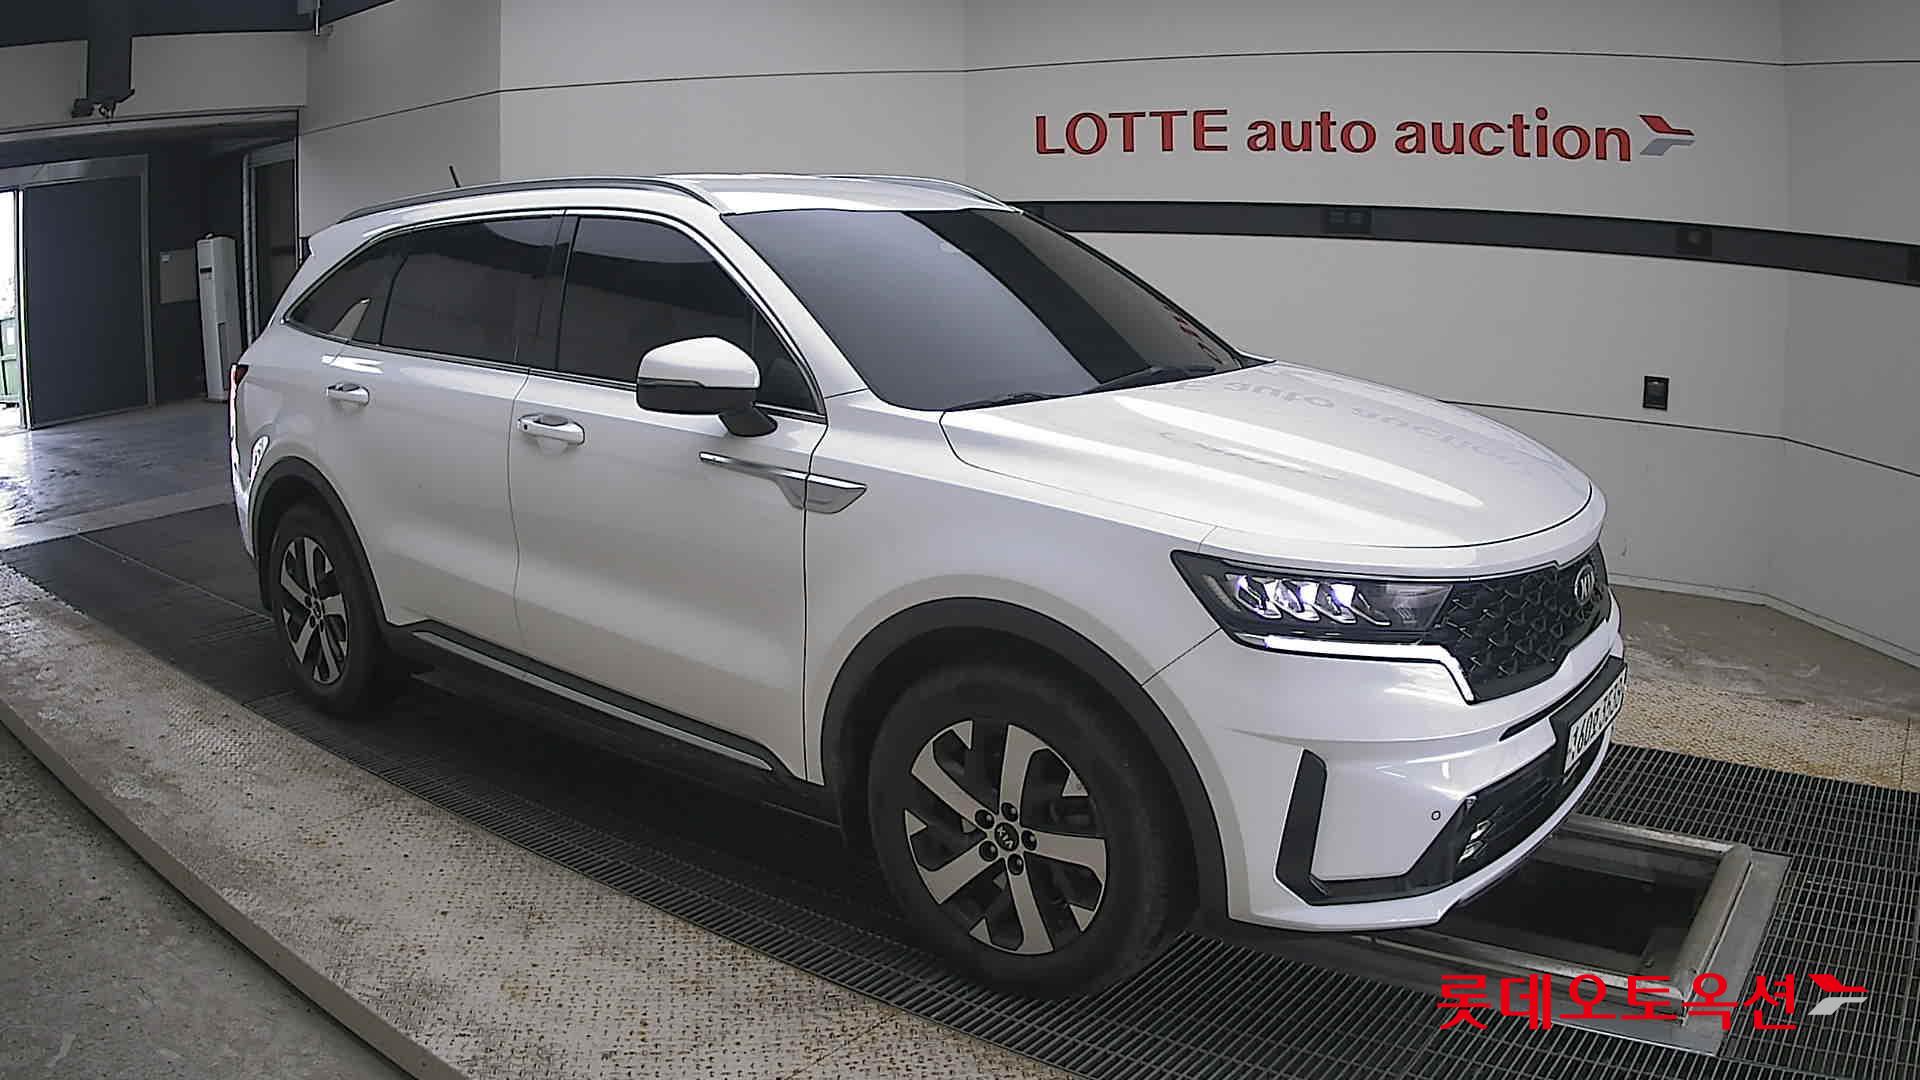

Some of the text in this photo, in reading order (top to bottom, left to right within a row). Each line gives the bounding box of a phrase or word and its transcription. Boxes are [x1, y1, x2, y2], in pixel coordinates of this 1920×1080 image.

[1035, 106, 1632, 162] LOTTE auto auction
[996, 826, 1014, 849] KIA
